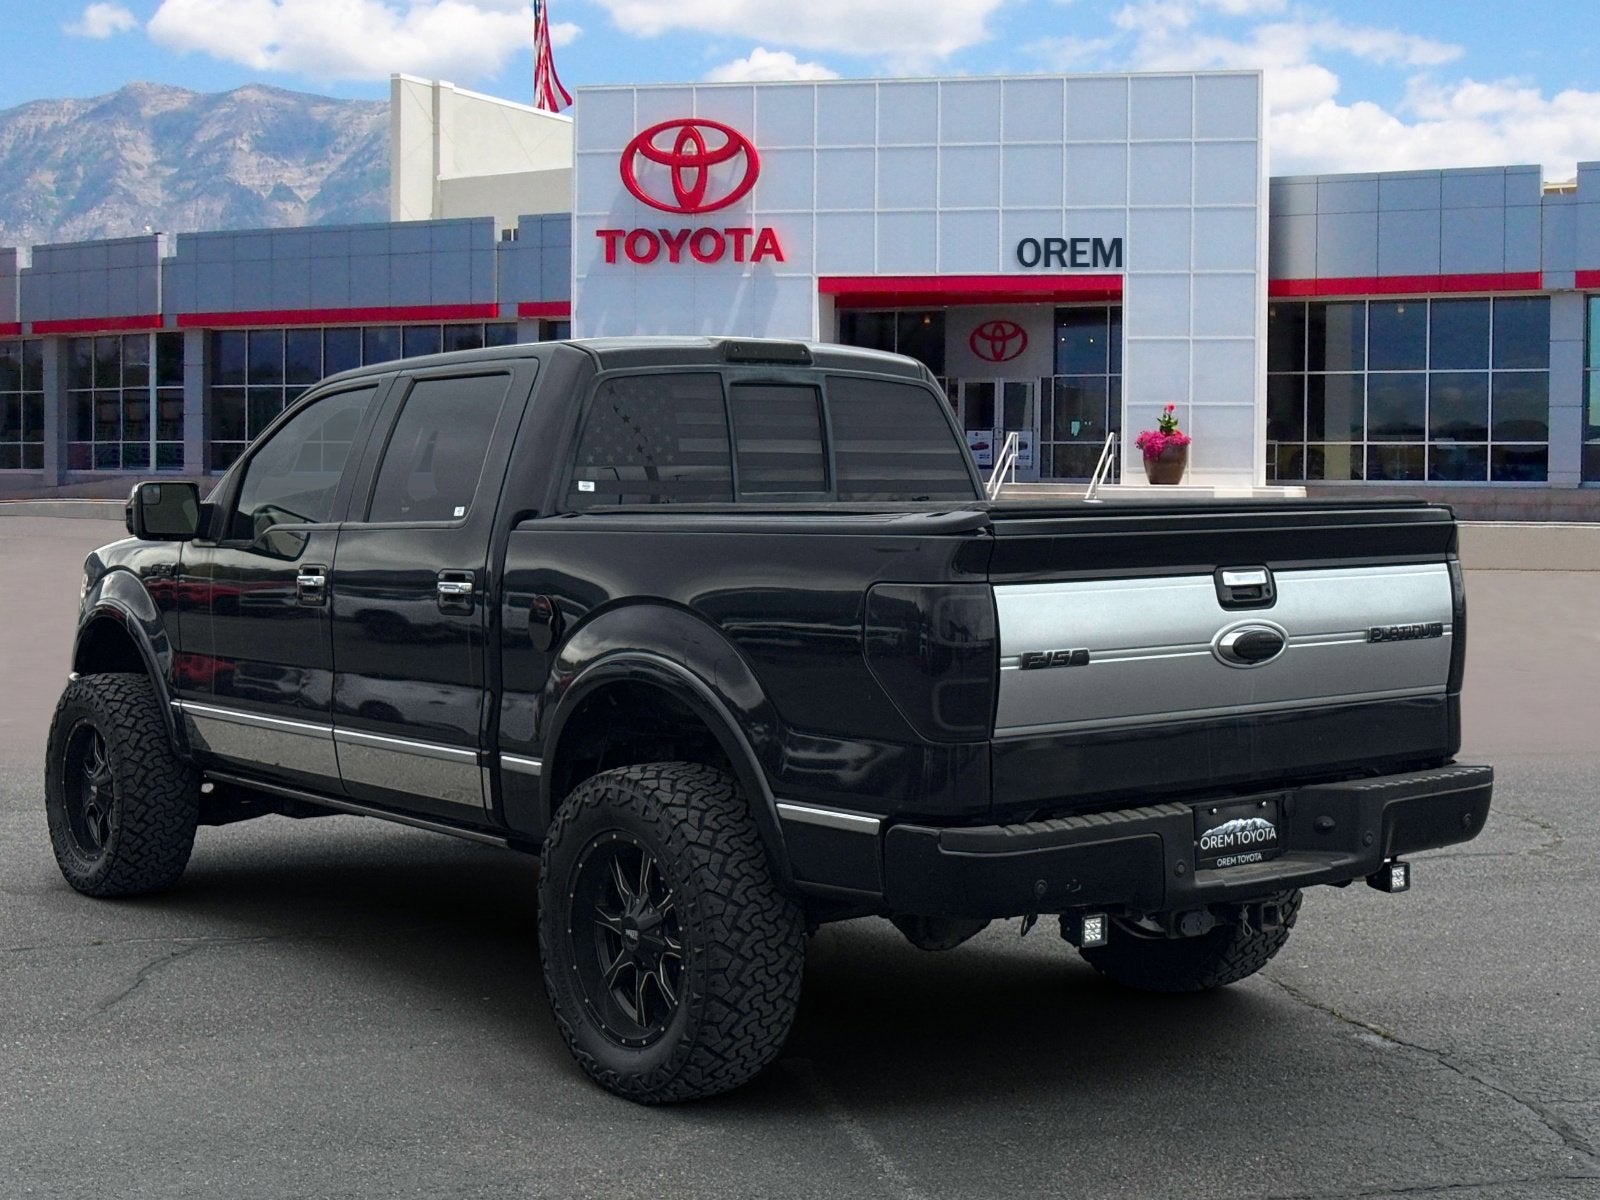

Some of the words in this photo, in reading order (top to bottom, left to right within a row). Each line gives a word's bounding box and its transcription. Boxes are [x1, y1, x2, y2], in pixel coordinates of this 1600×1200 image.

[596, 227, 785, 264] TOYOTA
[1017, 237, 1123, 268] OREM
[1200, 834, 1234, 850] OREM
[1236, 828, 1277, 844] TOYOTA
[1216, 857, 1236, 867] OREM
[1237, 852, 1262, 863] TOYOTA
